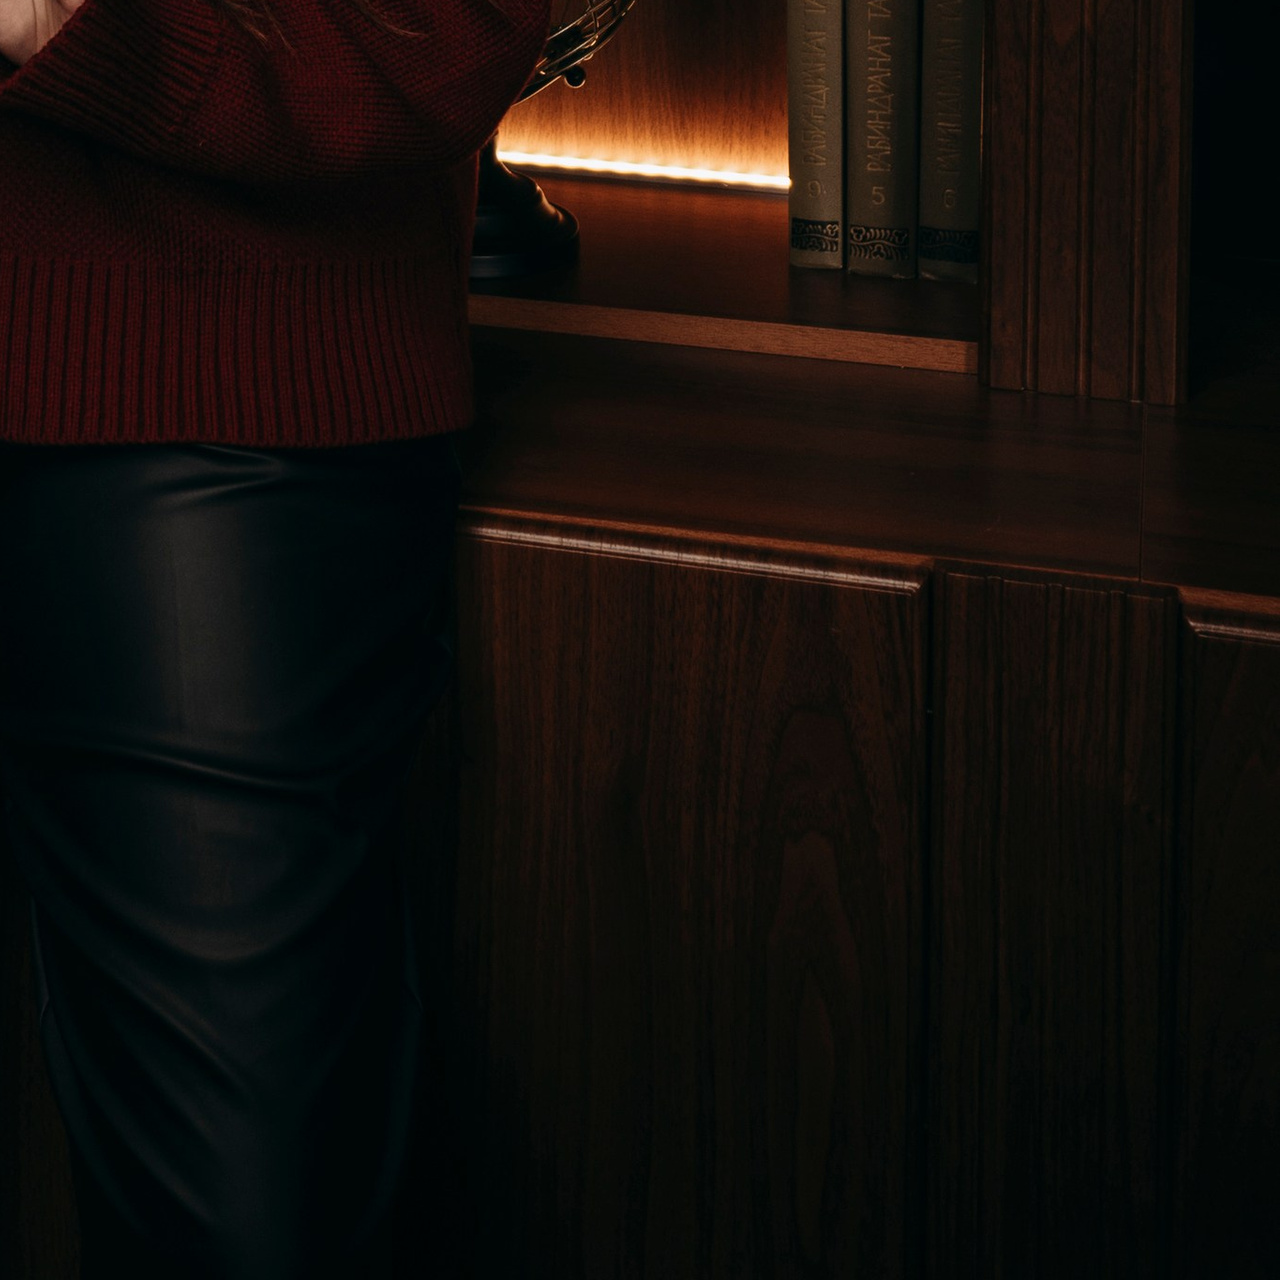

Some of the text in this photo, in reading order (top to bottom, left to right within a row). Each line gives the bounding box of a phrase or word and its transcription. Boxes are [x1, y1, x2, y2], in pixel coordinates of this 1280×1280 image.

[802, 24, 830, 167] РАБИНДРАНАТ
[866, 29, 895, 172] РАБИНДРАНАТ
[872, 186, 886, 206] 5
